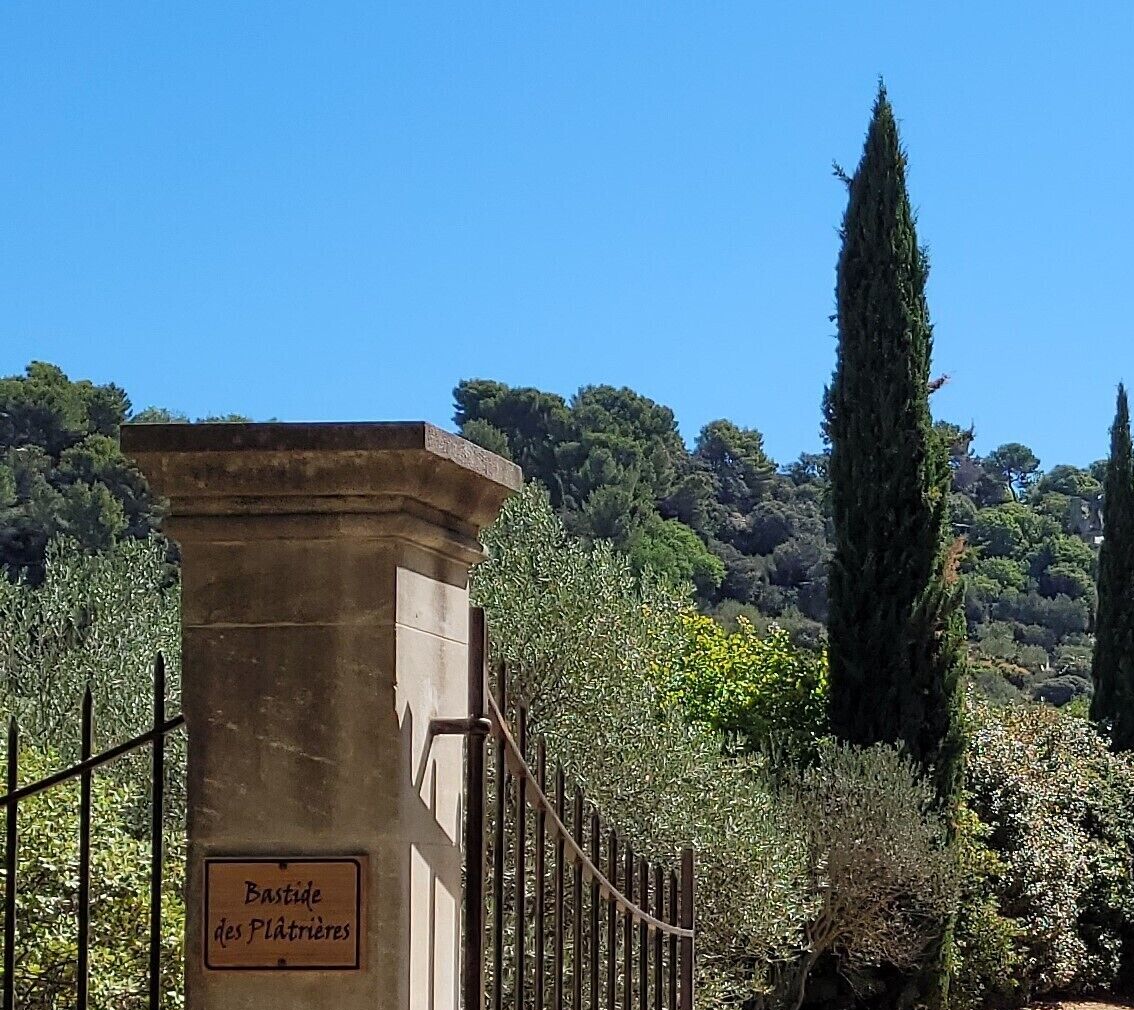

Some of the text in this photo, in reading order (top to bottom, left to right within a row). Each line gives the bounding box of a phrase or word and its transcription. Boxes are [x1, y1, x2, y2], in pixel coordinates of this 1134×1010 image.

[244, 880, 322, 912] Bastide
[214, 915, 351, 948] des Plâtrières
